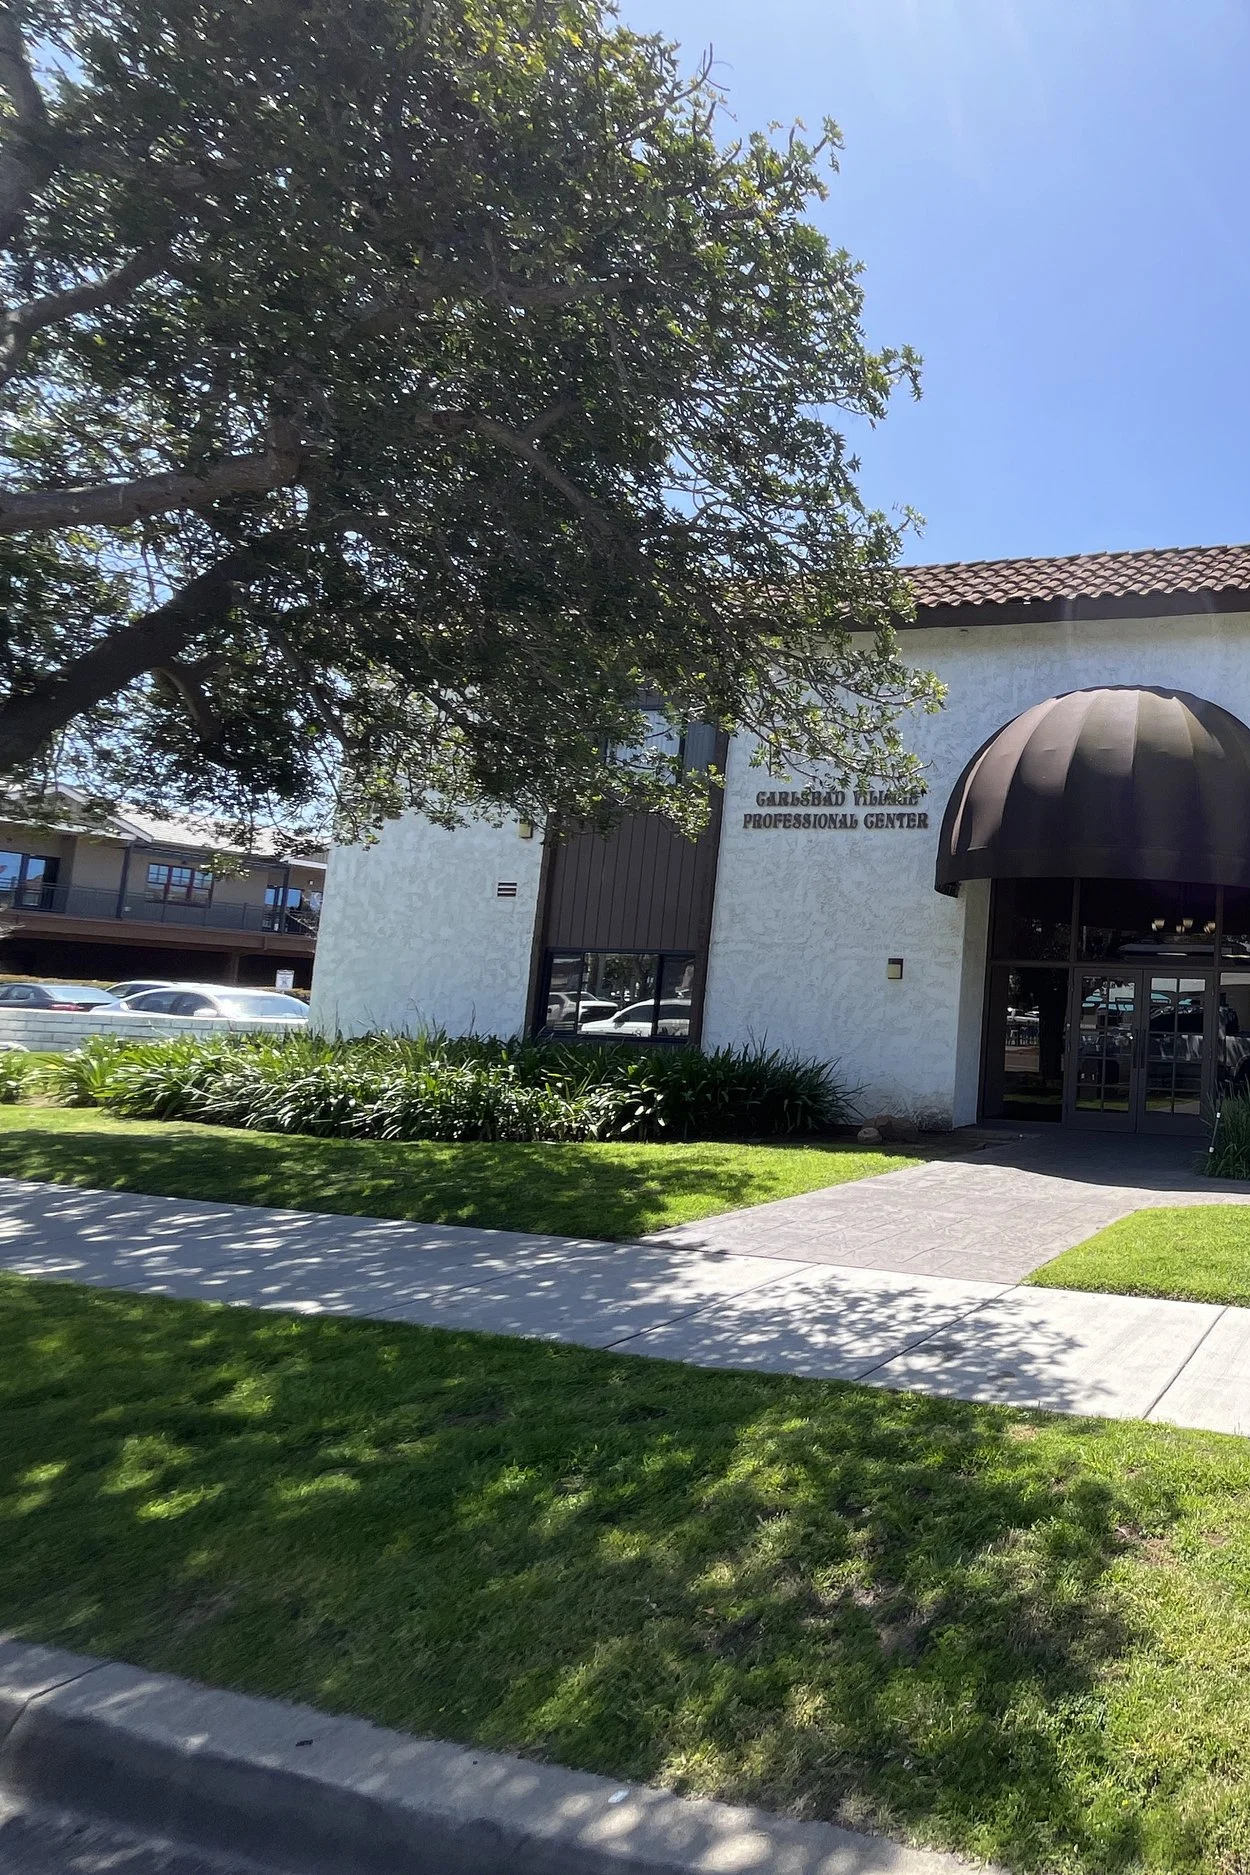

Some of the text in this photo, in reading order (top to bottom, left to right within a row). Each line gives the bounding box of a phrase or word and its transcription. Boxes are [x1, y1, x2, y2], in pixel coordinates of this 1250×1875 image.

[756, 790, 845, 807] CARLSBAD
[743, 812, 929, 829] PROFESSIONAL CENTER
